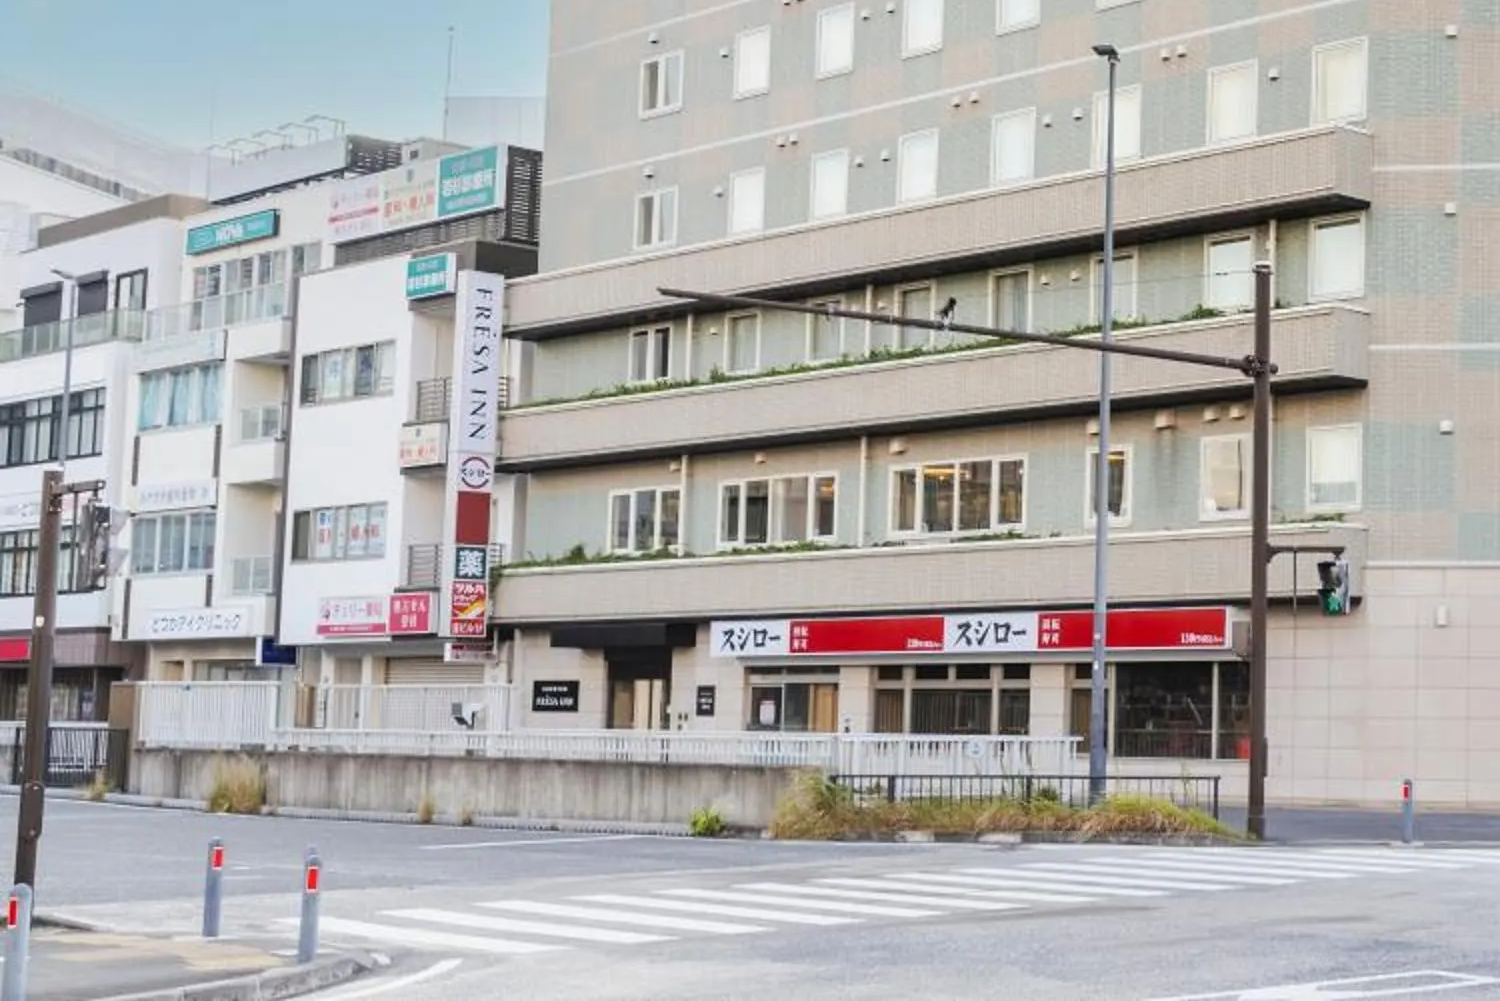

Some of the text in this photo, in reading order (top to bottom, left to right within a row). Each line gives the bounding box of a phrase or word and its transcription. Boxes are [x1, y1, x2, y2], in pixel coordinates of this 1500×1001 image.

[468, 389, 488, 440] INN
[458, 549, 485, 577] 薬
[720, 627, 782, 650] スシロー
[954, 619, 1028, 646] スシロー
